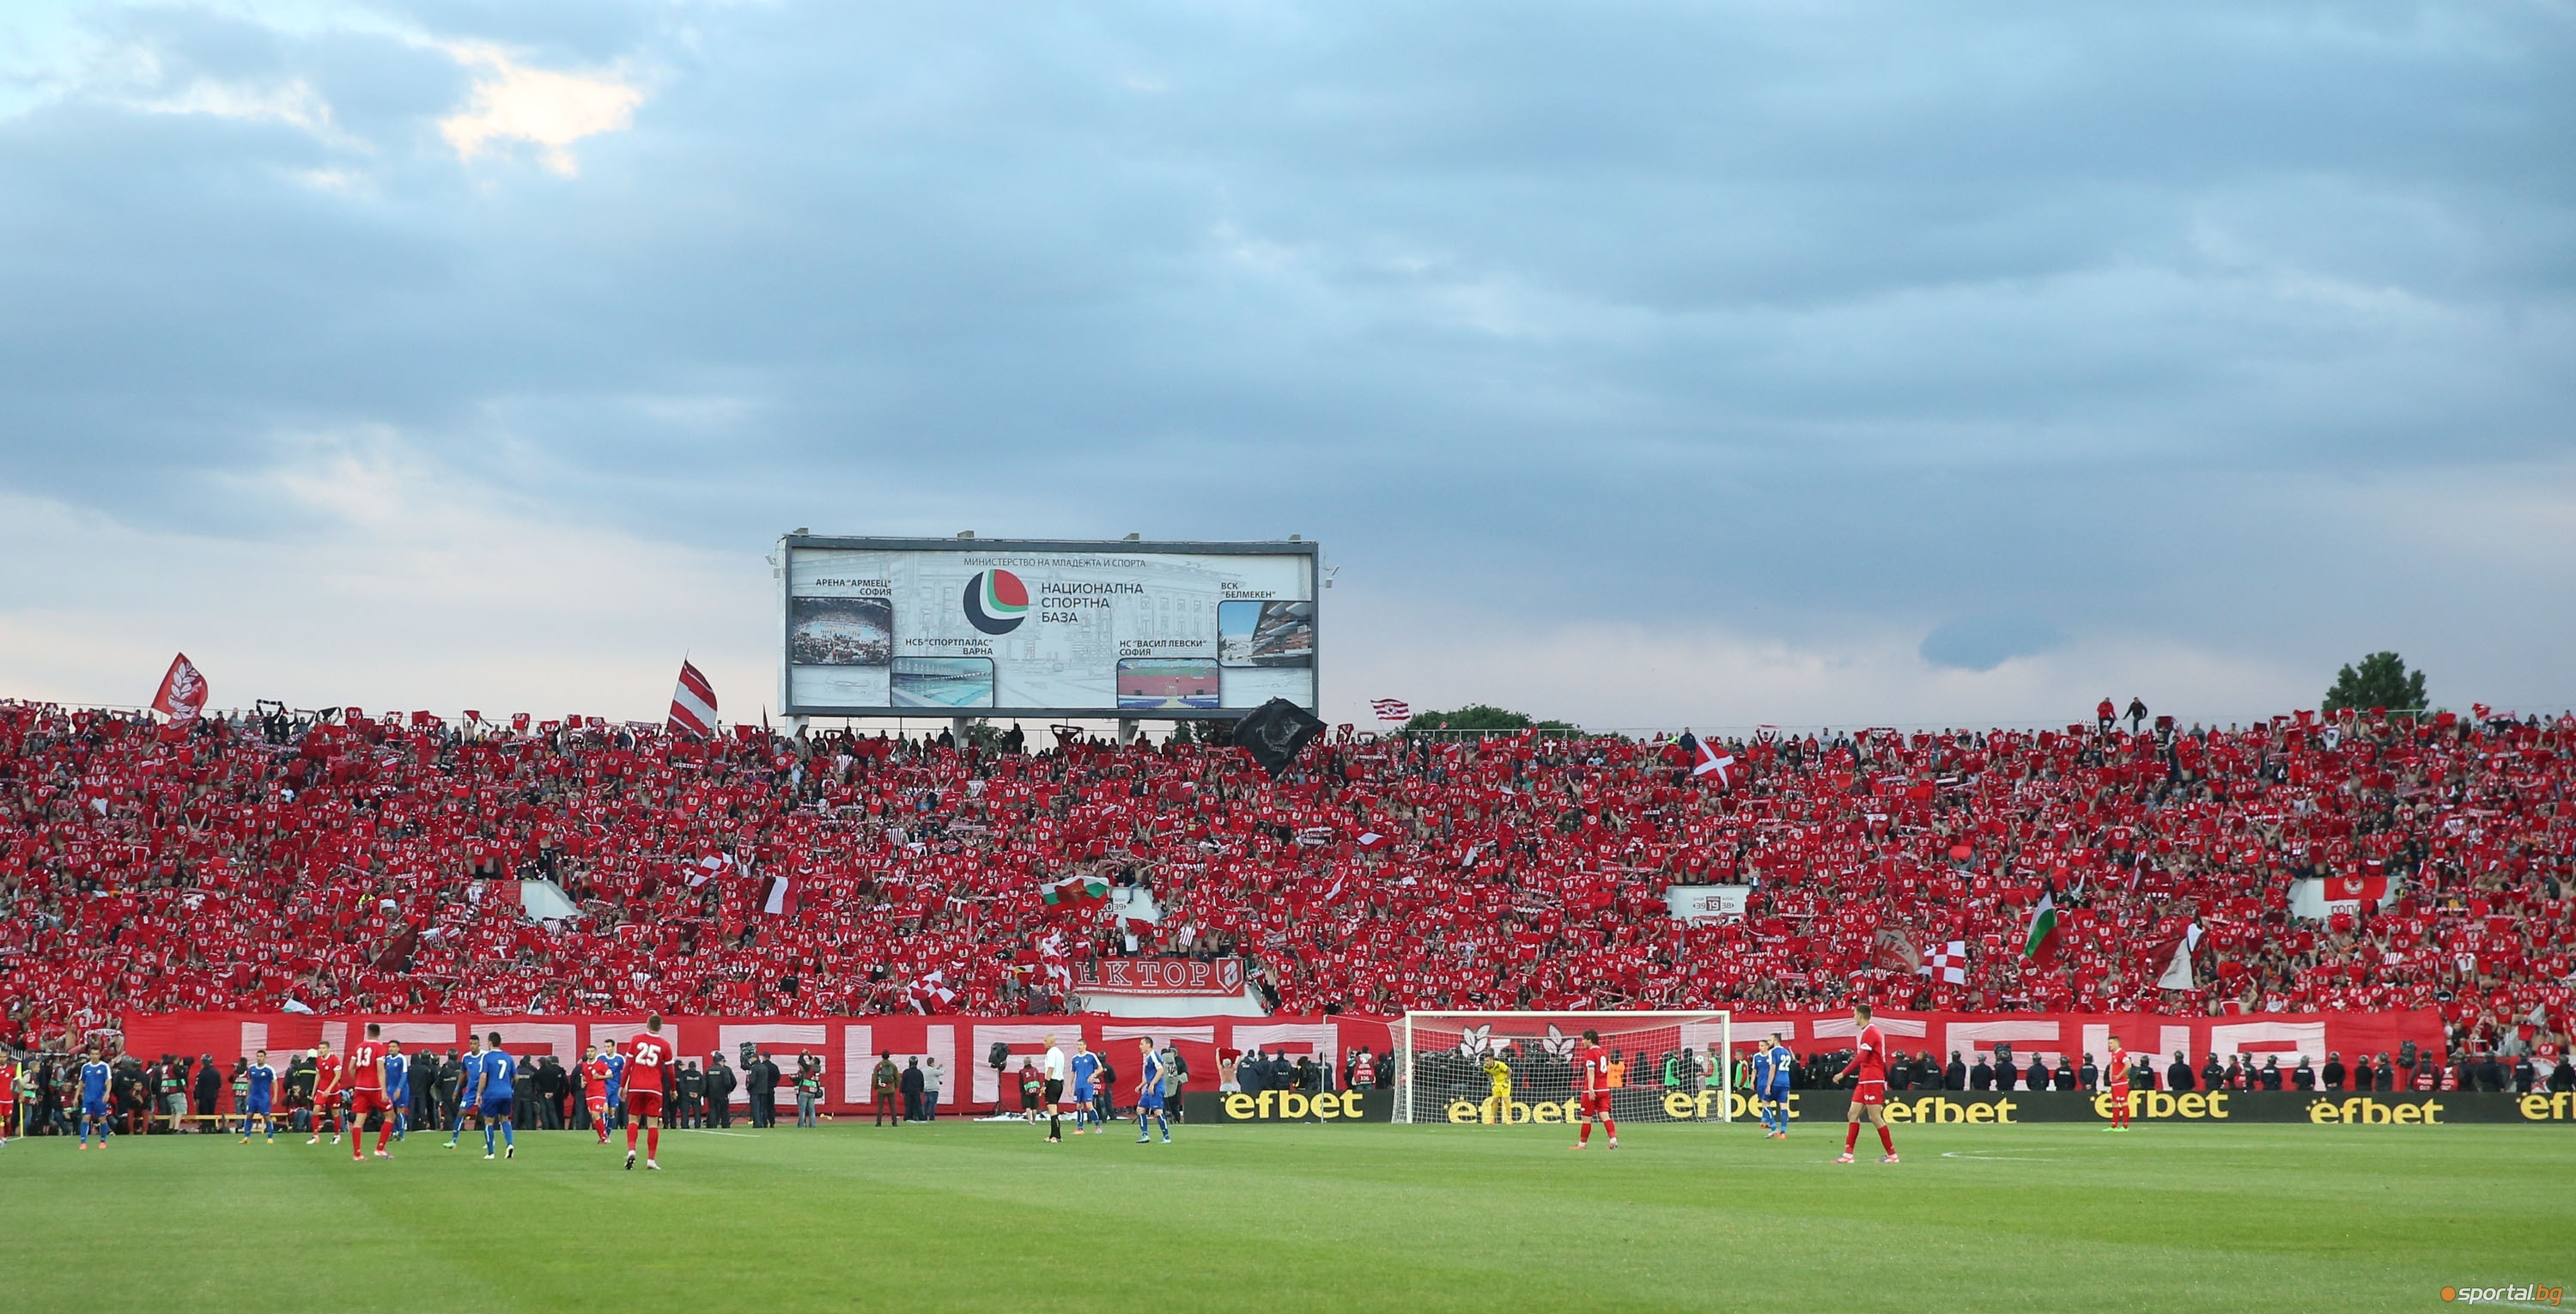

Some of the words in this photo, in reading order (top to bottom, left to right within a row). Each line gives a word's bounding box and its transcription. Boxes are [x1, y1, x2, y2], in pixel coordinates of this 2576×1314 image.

[963, 558, 1036, 567] МИНИСТЕРСТВО
[1037, 558, 1050, 567] НА
[1052, 558, 1102, 569] МЛАДЕЖТА
[1112, 559, 1146, 568] СПОРТА
[860, 587, 892, 596] СОФИЯ
[1042, 583, 1144, 597] НАЦИОНАЛНА
[1042, 598, 1110, 609] СПОРТНА
[1042, 611, 1078, 624] БАЗА
[1708, 901, 1718, 910] 19
[1075, 960, 1210, 987] ЕКТОР
[356, 1046, 373, 1067] 13
[635, 1042, 661, 1067] 25
[1780, 1054, 1791, 1072] 22
[497, 1059, 507, 1080] 7
[1224, 1090, 1364, 1119] efbet
[1881, 1097, 2017, 1124] efbet
[2093, 1090, 2229, 1119] efbet
[2309, 1098, 2445, 1124] efbet
[2519, 1092, 2576, 1120] ef
